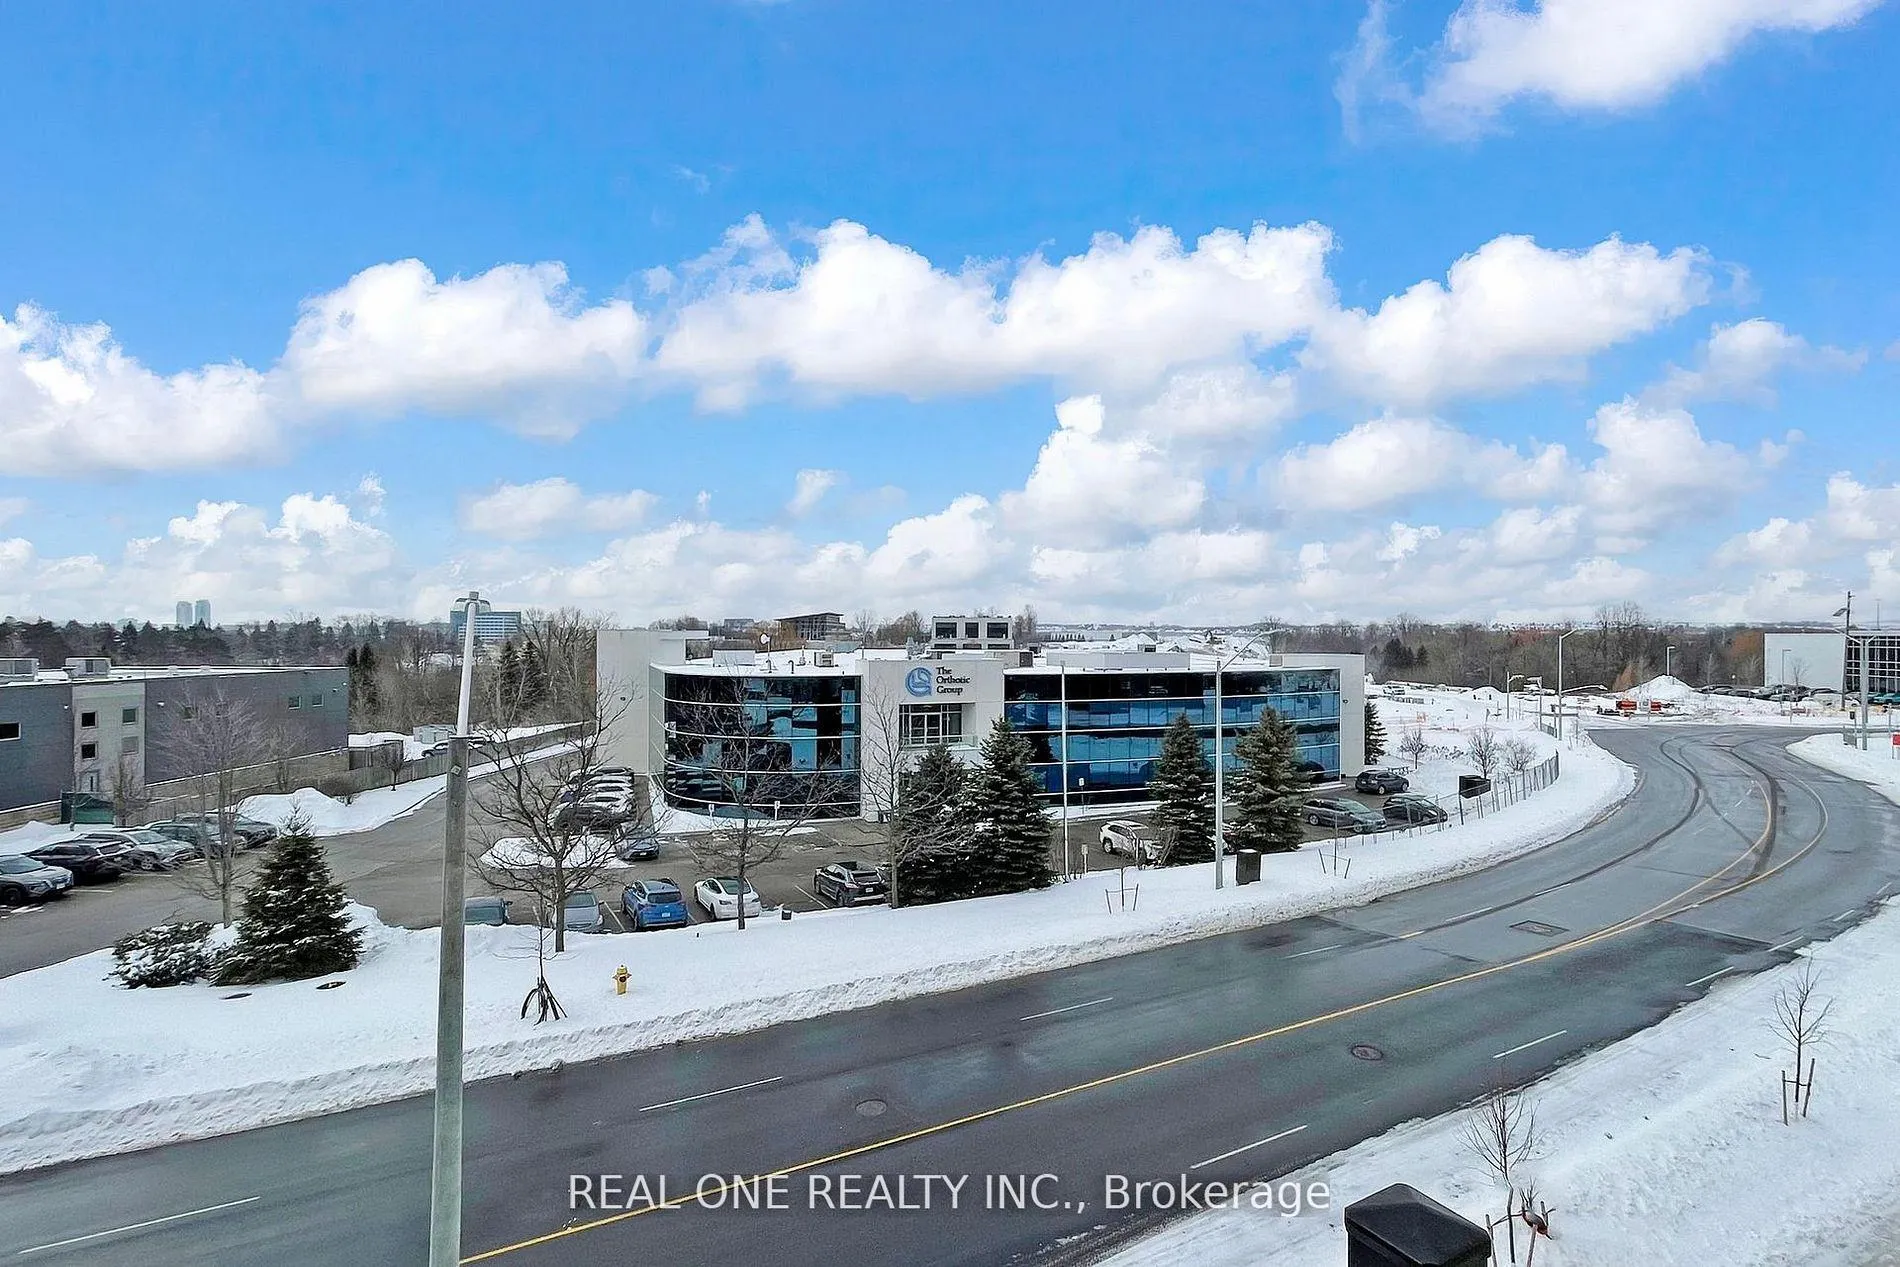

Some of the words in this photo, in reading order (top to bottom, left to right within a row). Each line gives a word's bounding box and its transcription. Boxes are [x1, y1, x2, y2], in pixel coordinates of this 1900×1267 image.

[936, 666, 952, 675] The
[936, 675, 971, 684] Orthotic
[936, 685, 963, 695] Group
